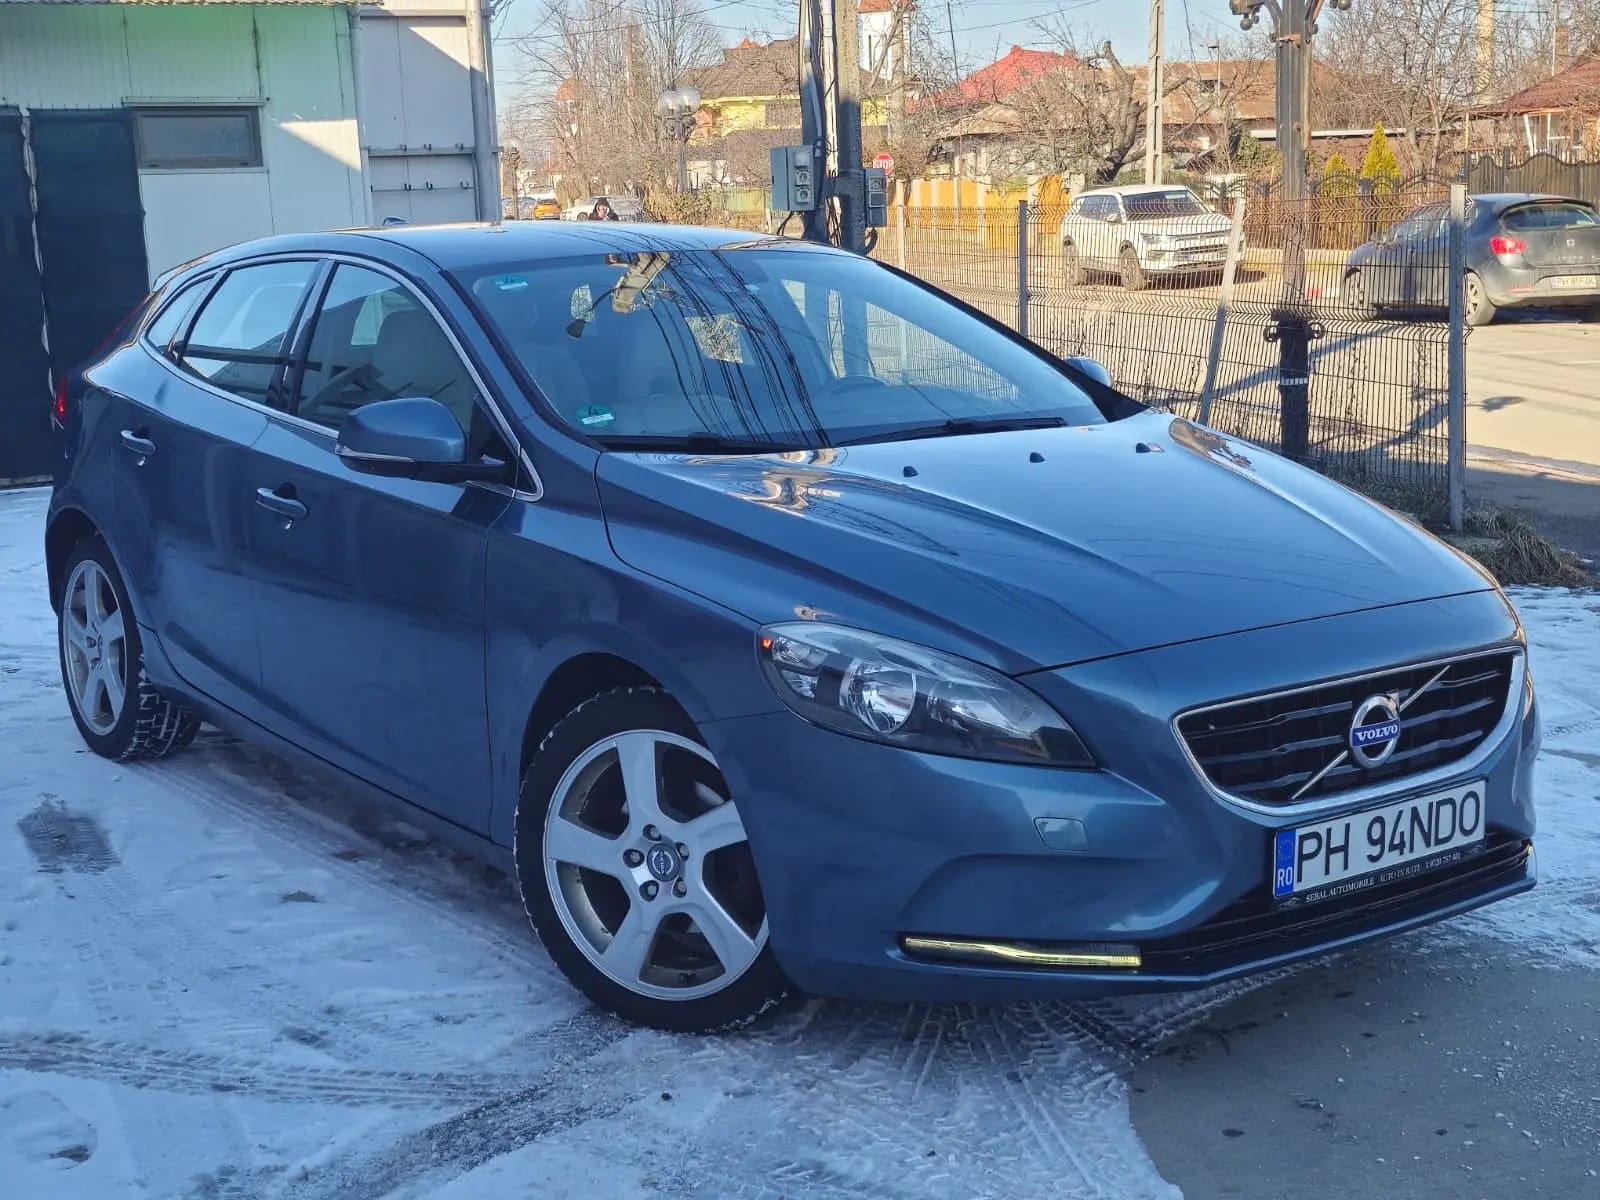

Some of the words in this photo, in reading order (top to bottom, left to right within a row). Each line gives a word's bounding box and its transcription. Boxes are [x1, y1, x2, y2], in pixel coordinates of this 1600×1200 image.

[874, 159, 894, 169] STOP
[1355, 725, 1398, 740] VOLVO
[1296, 823, 1351, 883] PH
[1366, 790, 1481, 863] 94NDO
[1277, 866, 1293, 888] RO
[1328, 876, 1375, 897] AUTOMOBILE
